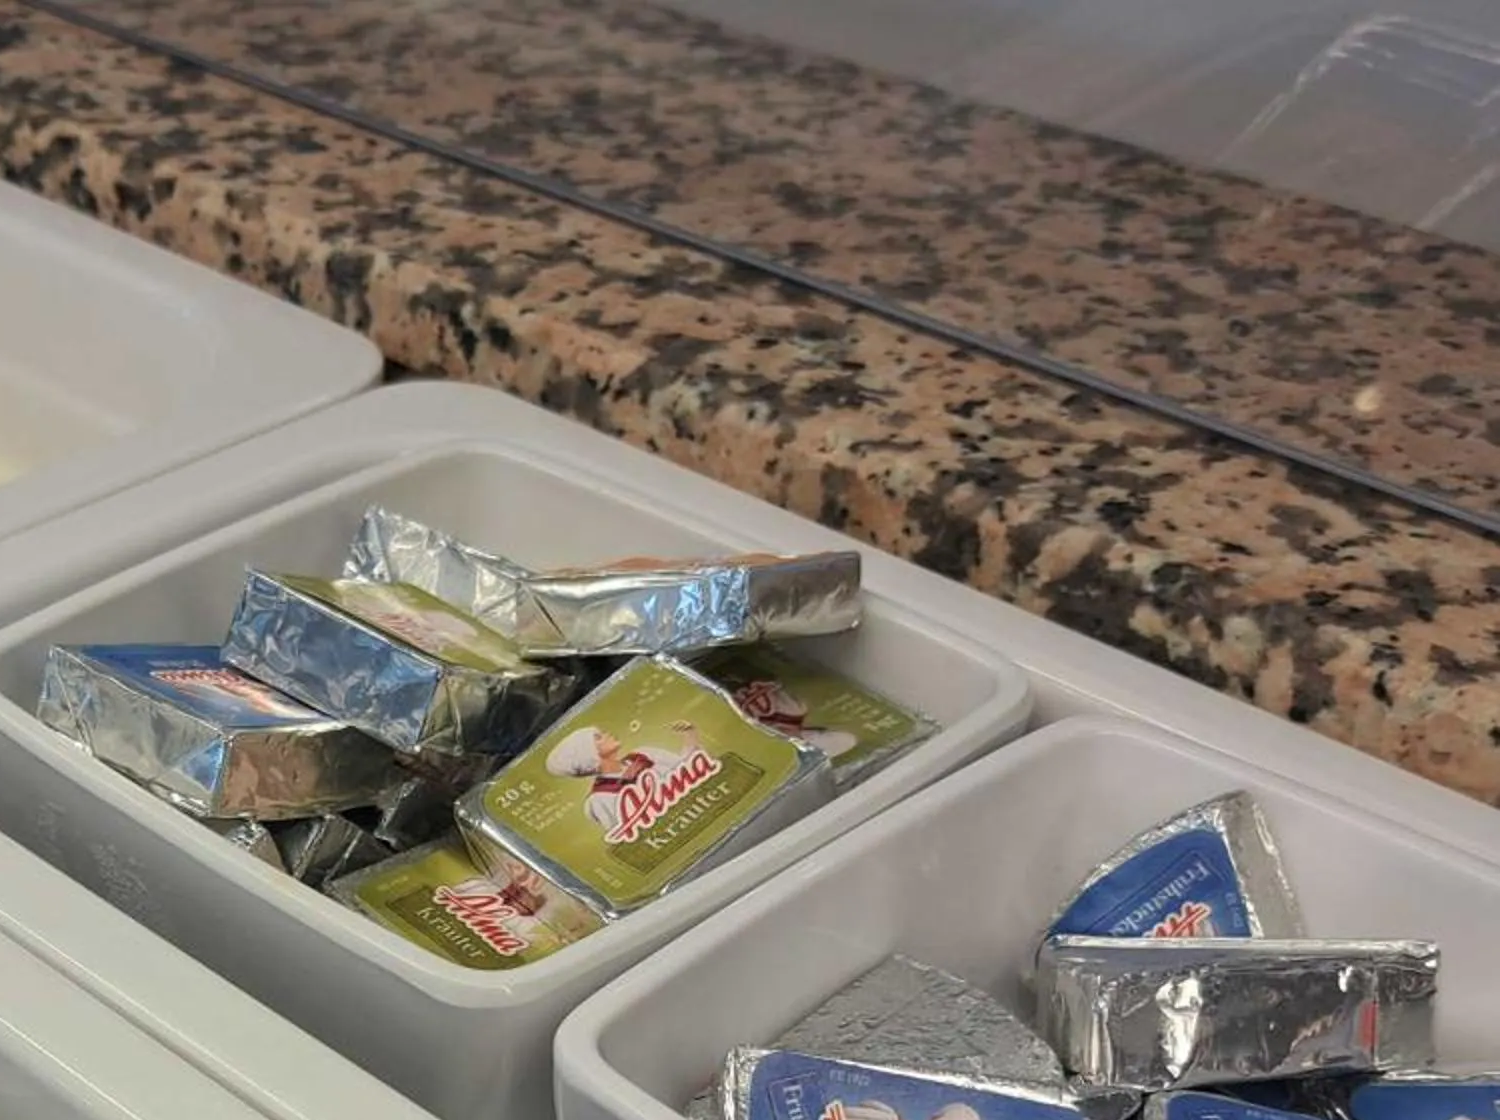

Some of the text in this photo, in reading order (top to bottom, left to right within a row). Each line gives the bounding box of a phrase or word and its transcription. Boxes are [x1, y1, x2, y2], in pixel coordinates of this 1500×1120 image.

[495, 786, 520, 810] 20
[607, 750, 720, 842] Alma
[645, 780, 732, 850] Kräuter
[417, 907, 488, 959] Kräuter
[433, 886, 529, 954] Alma
[1109, 861, 1212, 936] Frühstücks
